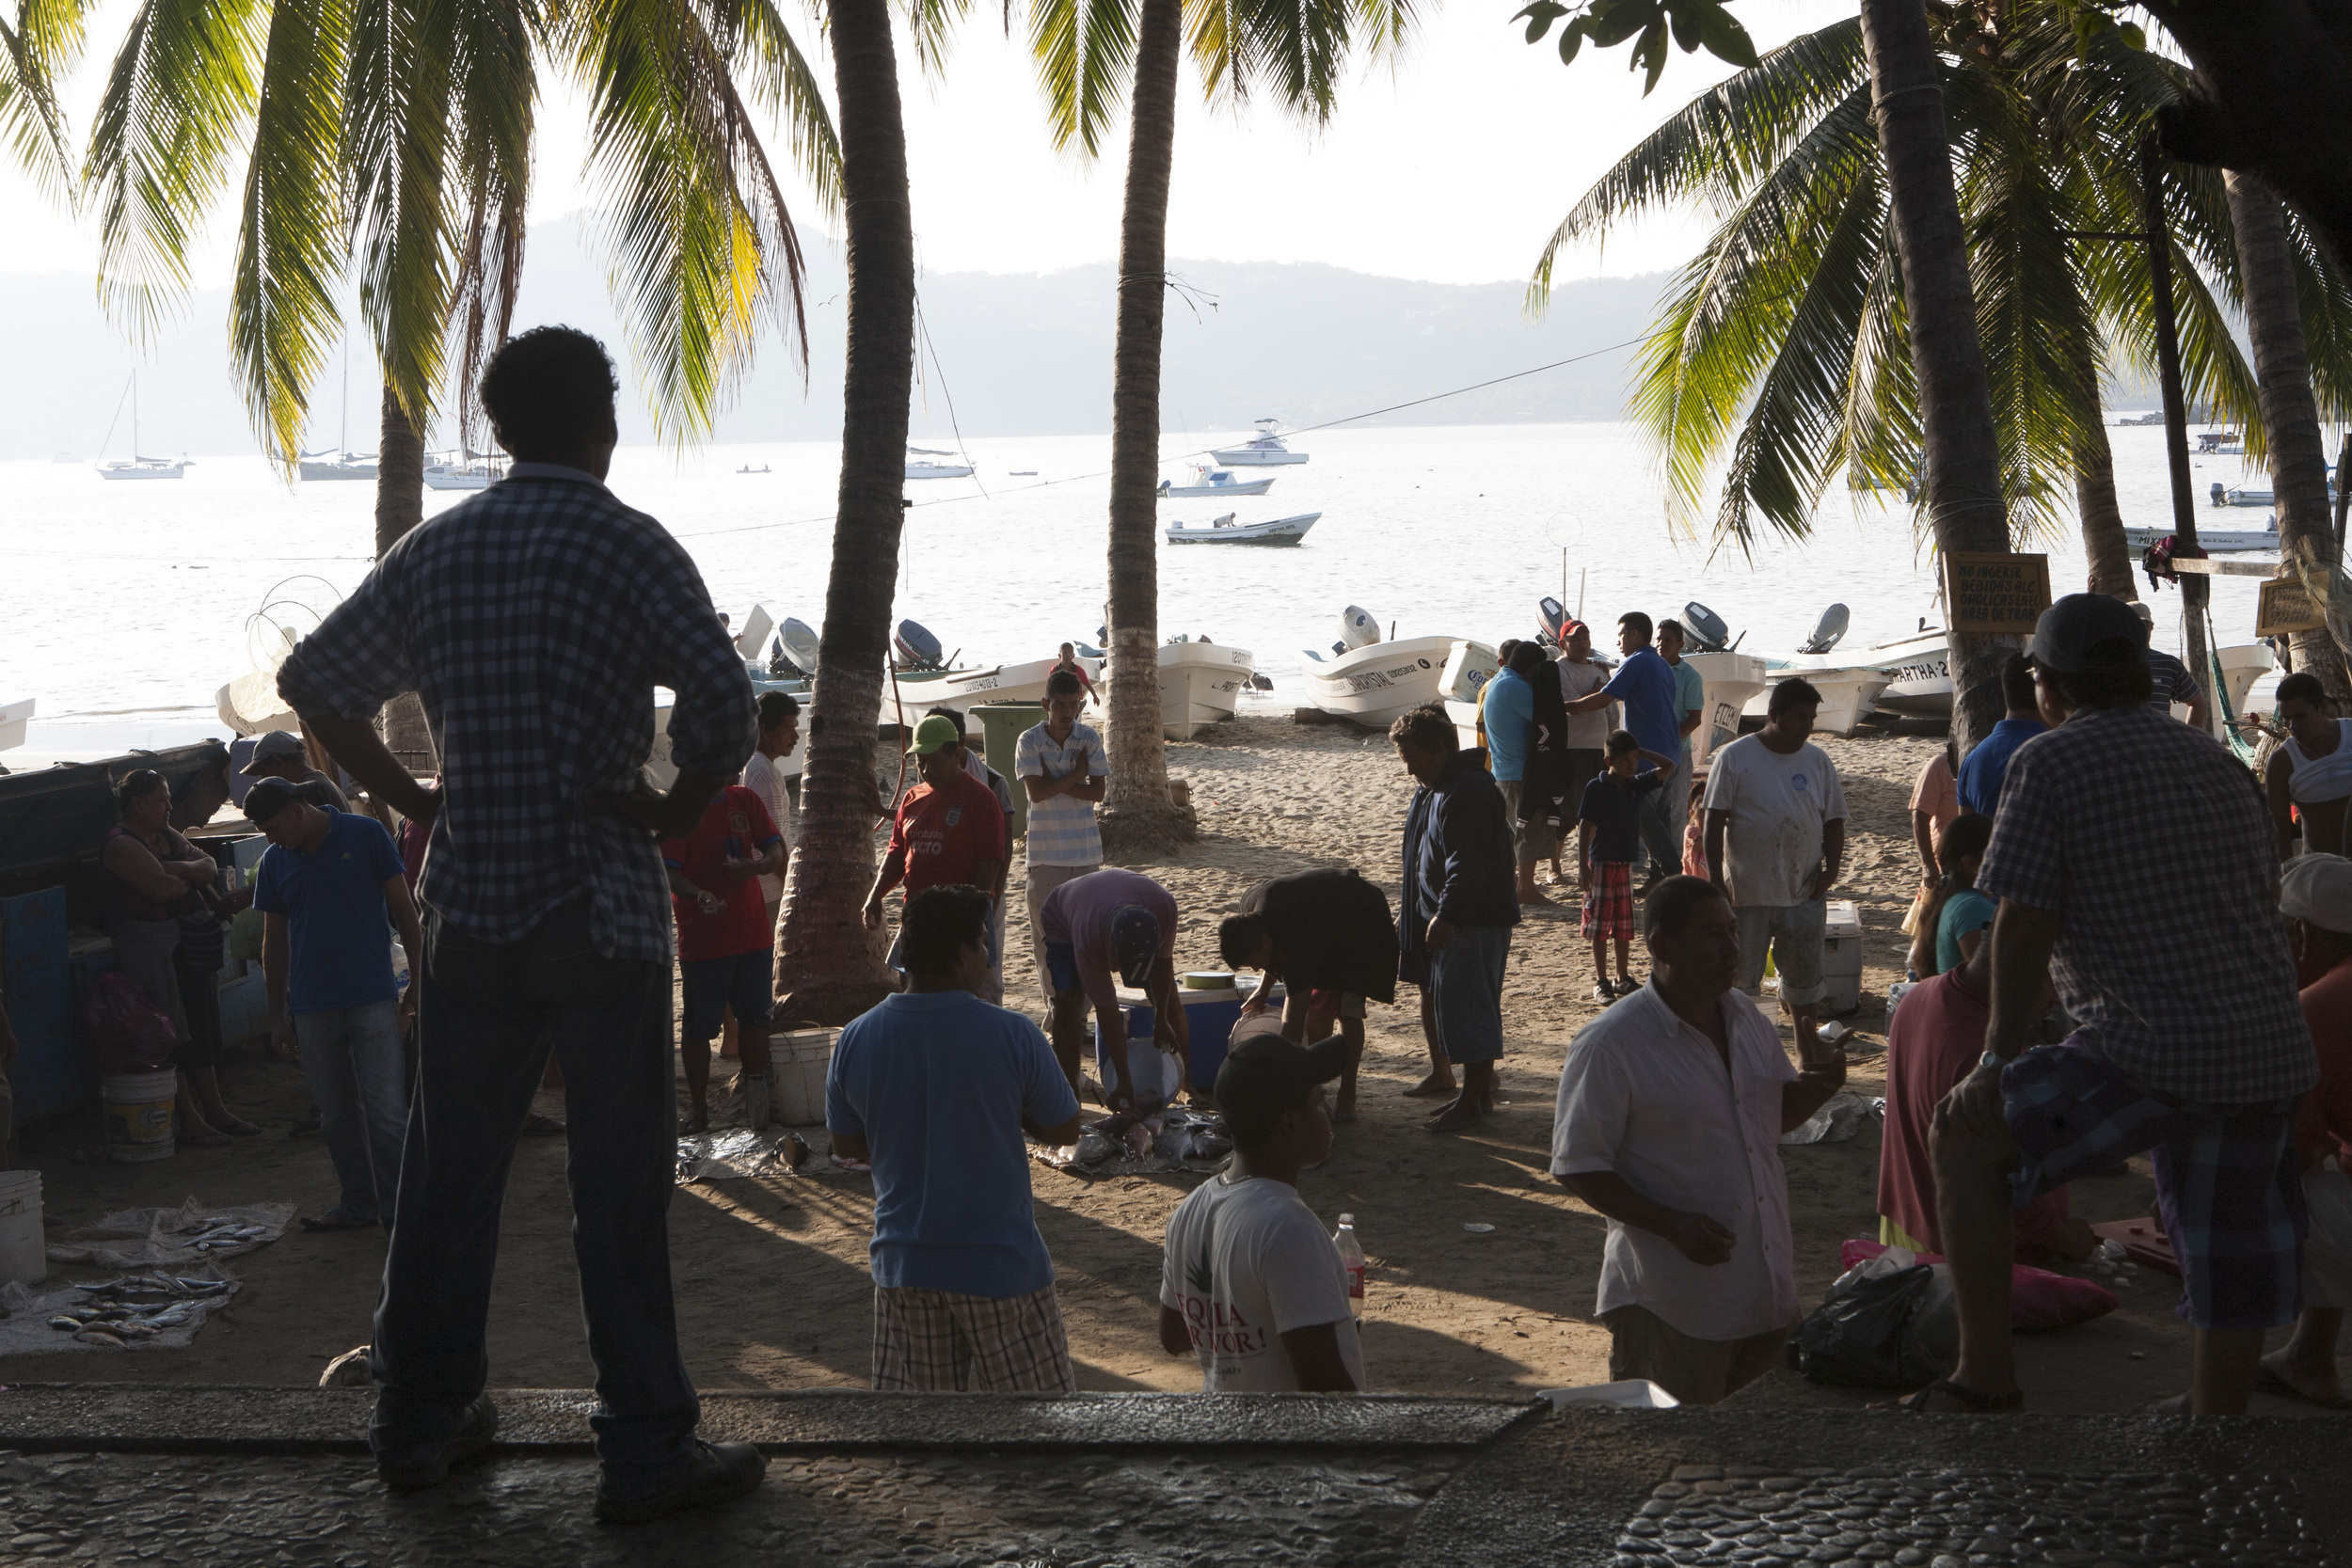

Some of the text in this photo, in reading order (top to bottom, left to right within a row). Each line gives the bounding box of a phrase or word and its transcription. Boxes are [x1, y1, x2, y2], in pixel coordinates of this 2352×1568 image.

[1958, 566, 2022, 579] NO INGERIR
[1961, 579, 2012, 594] BEBIDAS
[1962, 607, 1989, 620] AREA
[1992, 608, 2006, 621] DE
